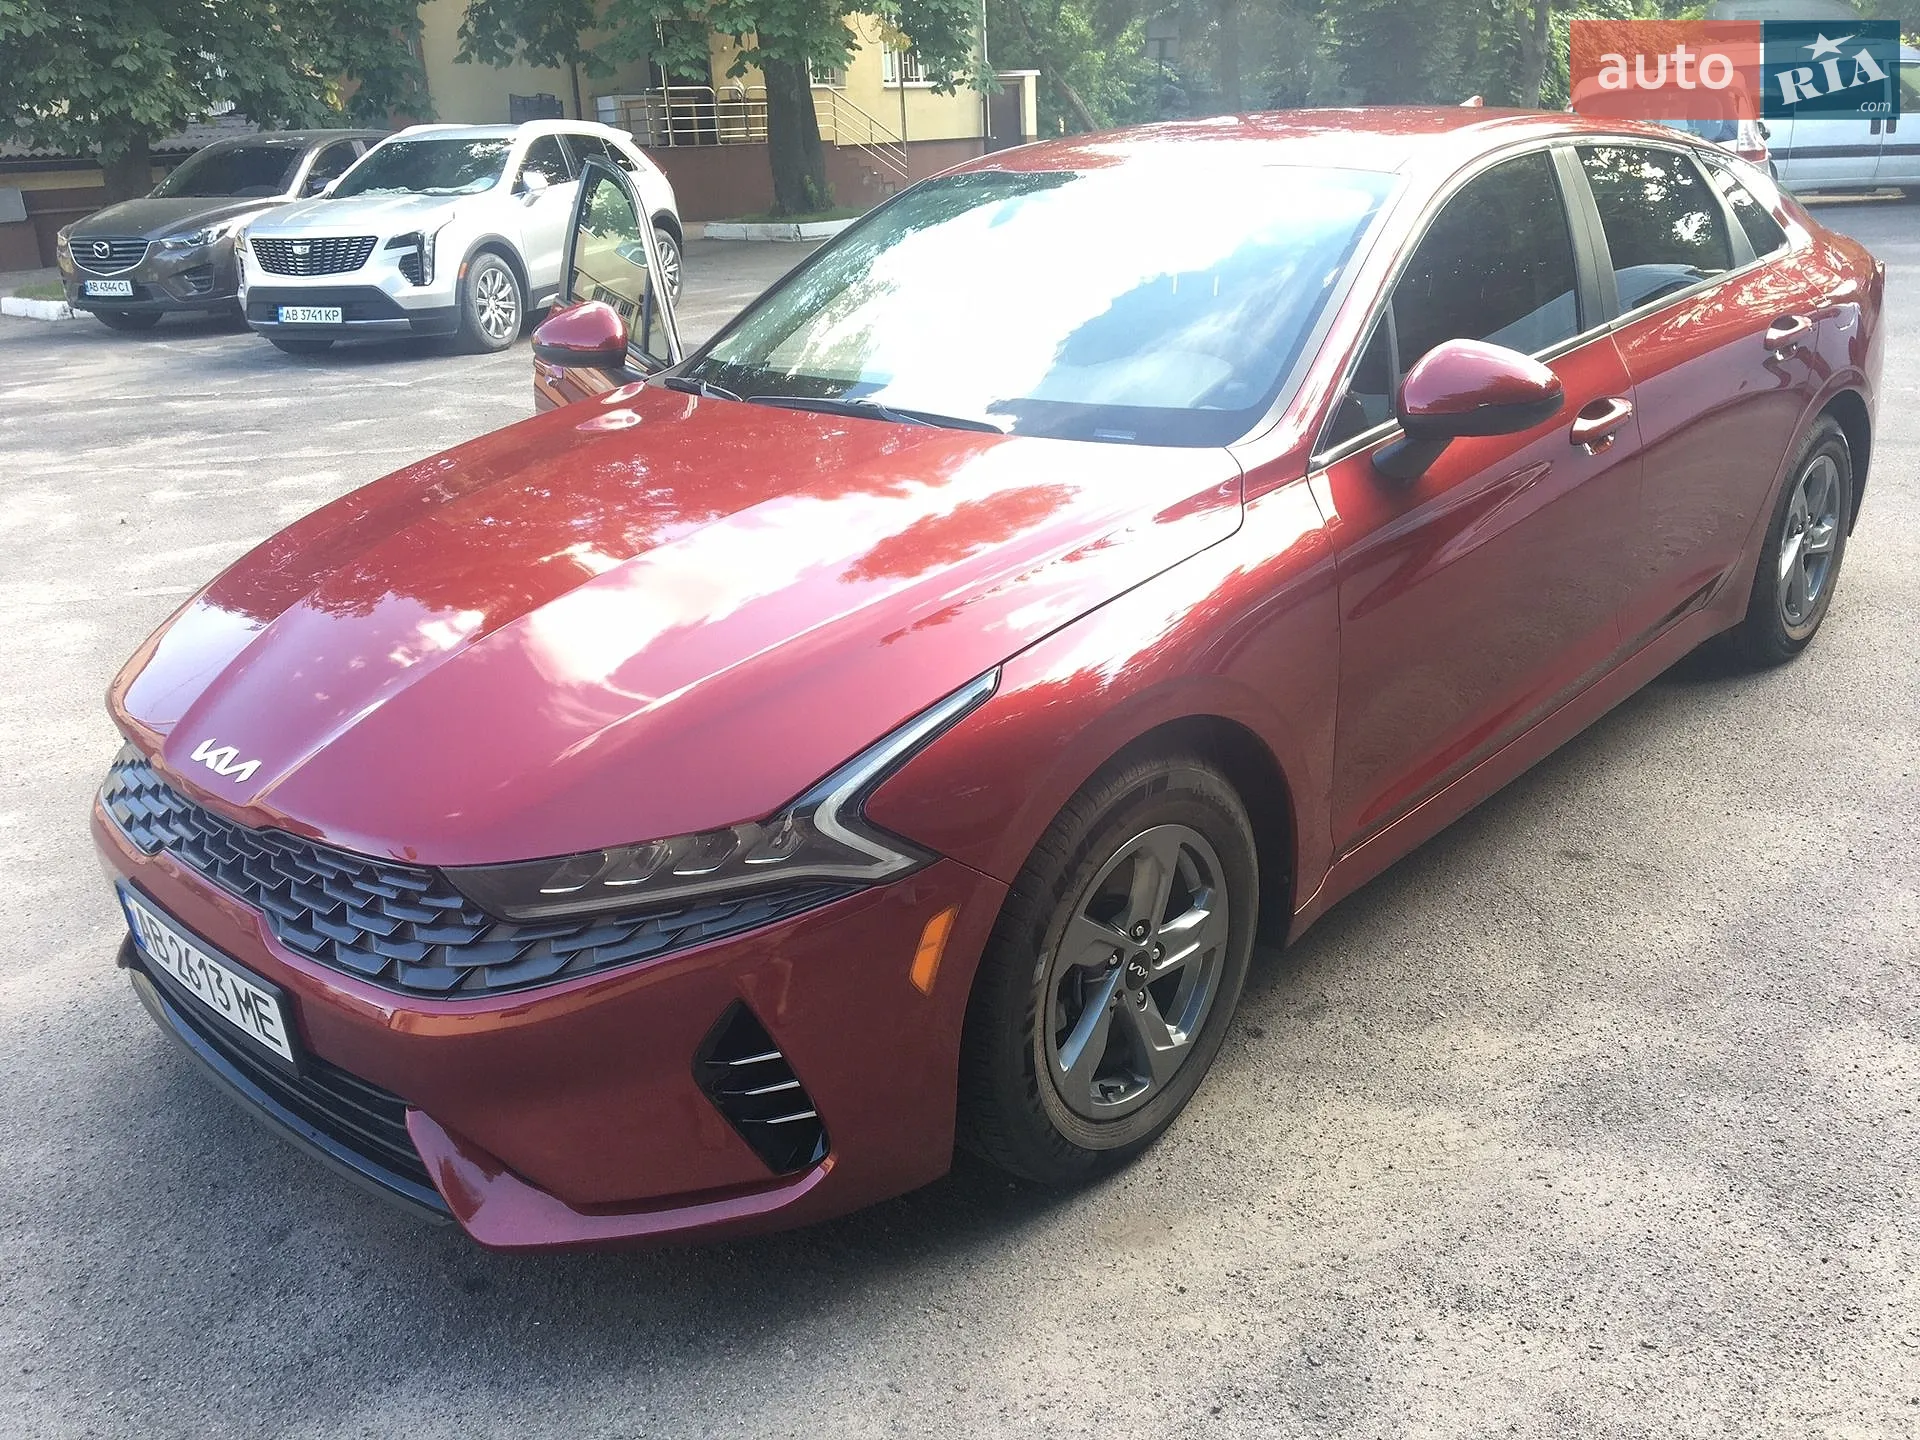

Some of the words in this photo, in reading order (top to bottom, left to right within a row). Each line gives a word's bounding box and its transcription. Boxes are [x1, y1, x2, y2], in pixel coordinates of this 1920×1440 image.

[100, 281, 117, 292] 4344
[285, 309, 298, 321] AB
[300, 309, 323, 321] 3741
[324, 309, 339, 321] KP
[190, 738, 262, 783] KIA
[136, 907, 171, 965] AB
[168, 935, 231, 1012] 2613
[230, 977, 283, 1049] ME
